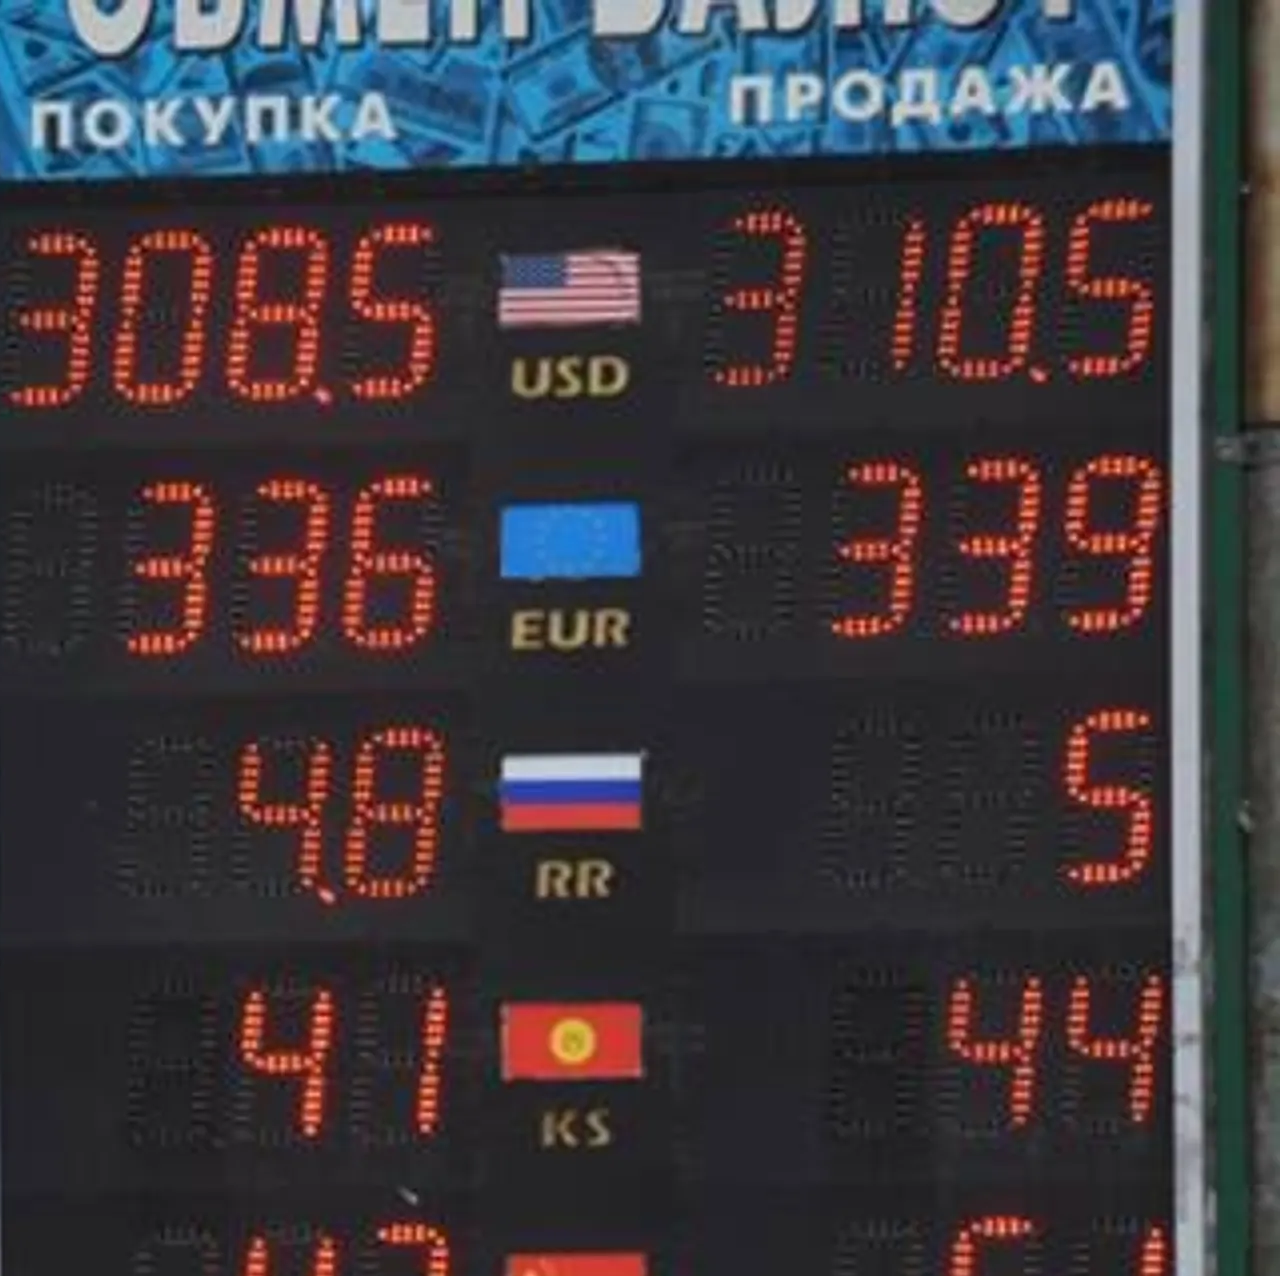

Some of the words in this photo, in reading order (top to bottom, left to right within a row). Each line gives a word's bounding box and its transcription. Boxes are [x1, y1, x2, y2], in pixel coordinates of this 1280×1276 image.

[29, 92, 397, 149] ПОКУПКА
[728, 61, 1130, 127] ПРОДАЖА
[8, 220, 437, 409] 308.5
[713, 196, 1156, 389] 310.5
[510, 354, 631, 400] USD
[125, 473, 438, 657] 336
[829, 453, 1164, 640] 339
[509, 607, 631, 651] EUR
[236, 725, 447, 907] 4.8
[1062, 707, 1155, 887] 5
[535, 858, 614, 899] RR
[237, 985, 450, 1139] 41
[946, 974, 1165, 1127] 44
[541, 1110, 611, 1147] KS
